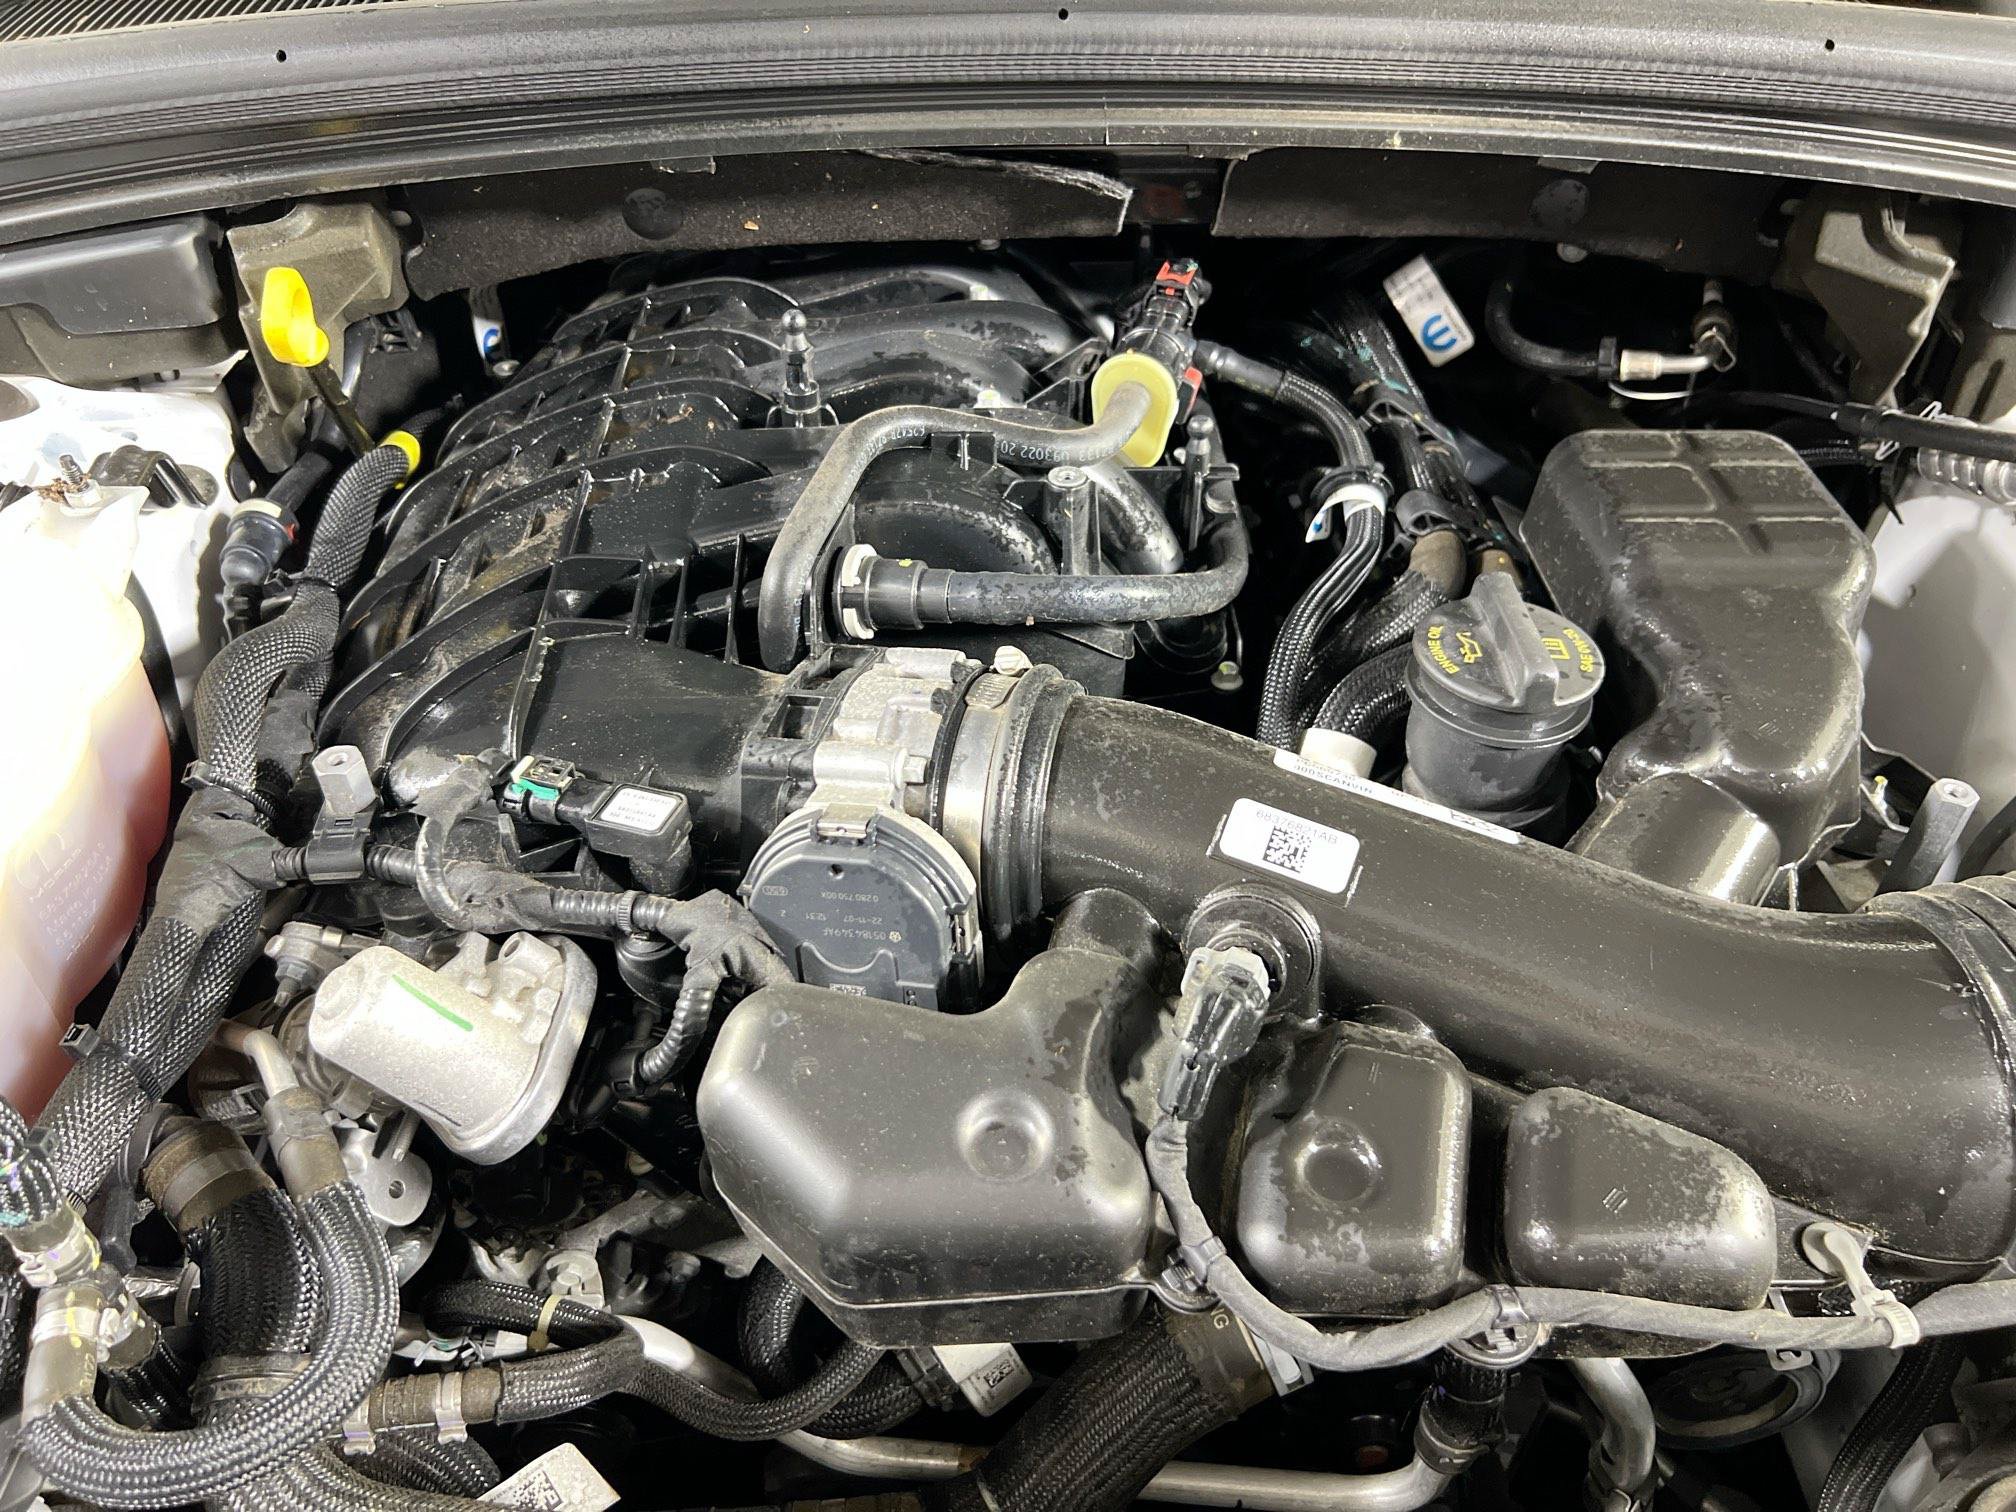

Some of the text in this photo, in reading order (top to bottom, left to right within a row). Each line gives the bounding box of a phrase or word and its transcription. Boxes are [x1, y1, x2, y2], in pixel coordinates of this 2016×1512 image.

[1428, 625, 1460, 674] ENGINE OIL
[1563, 628, 1594, 672] SAE 0W-20
[1256, 809, 1338, 845] 68376821AB
